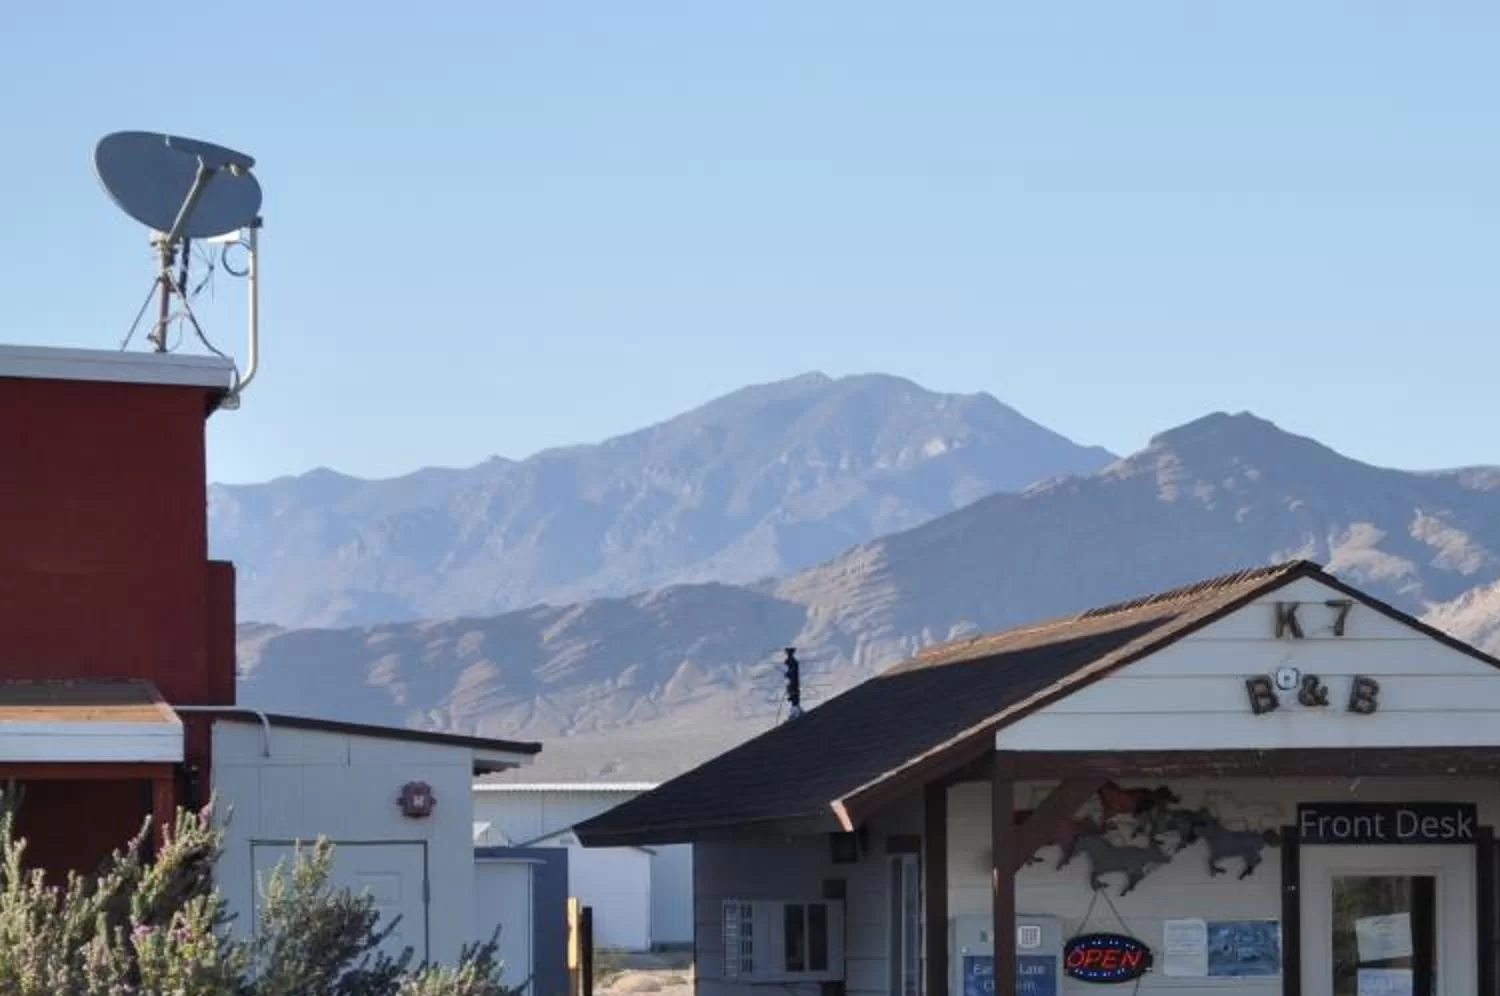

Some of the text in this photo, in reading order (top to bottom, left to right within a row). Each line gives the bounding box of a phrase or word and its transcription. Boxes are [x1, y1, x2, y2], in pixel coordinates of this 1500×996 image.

[1300, 808, 1473, 838] Front Desk
[1067, 949, 1144, 969] OPEN
